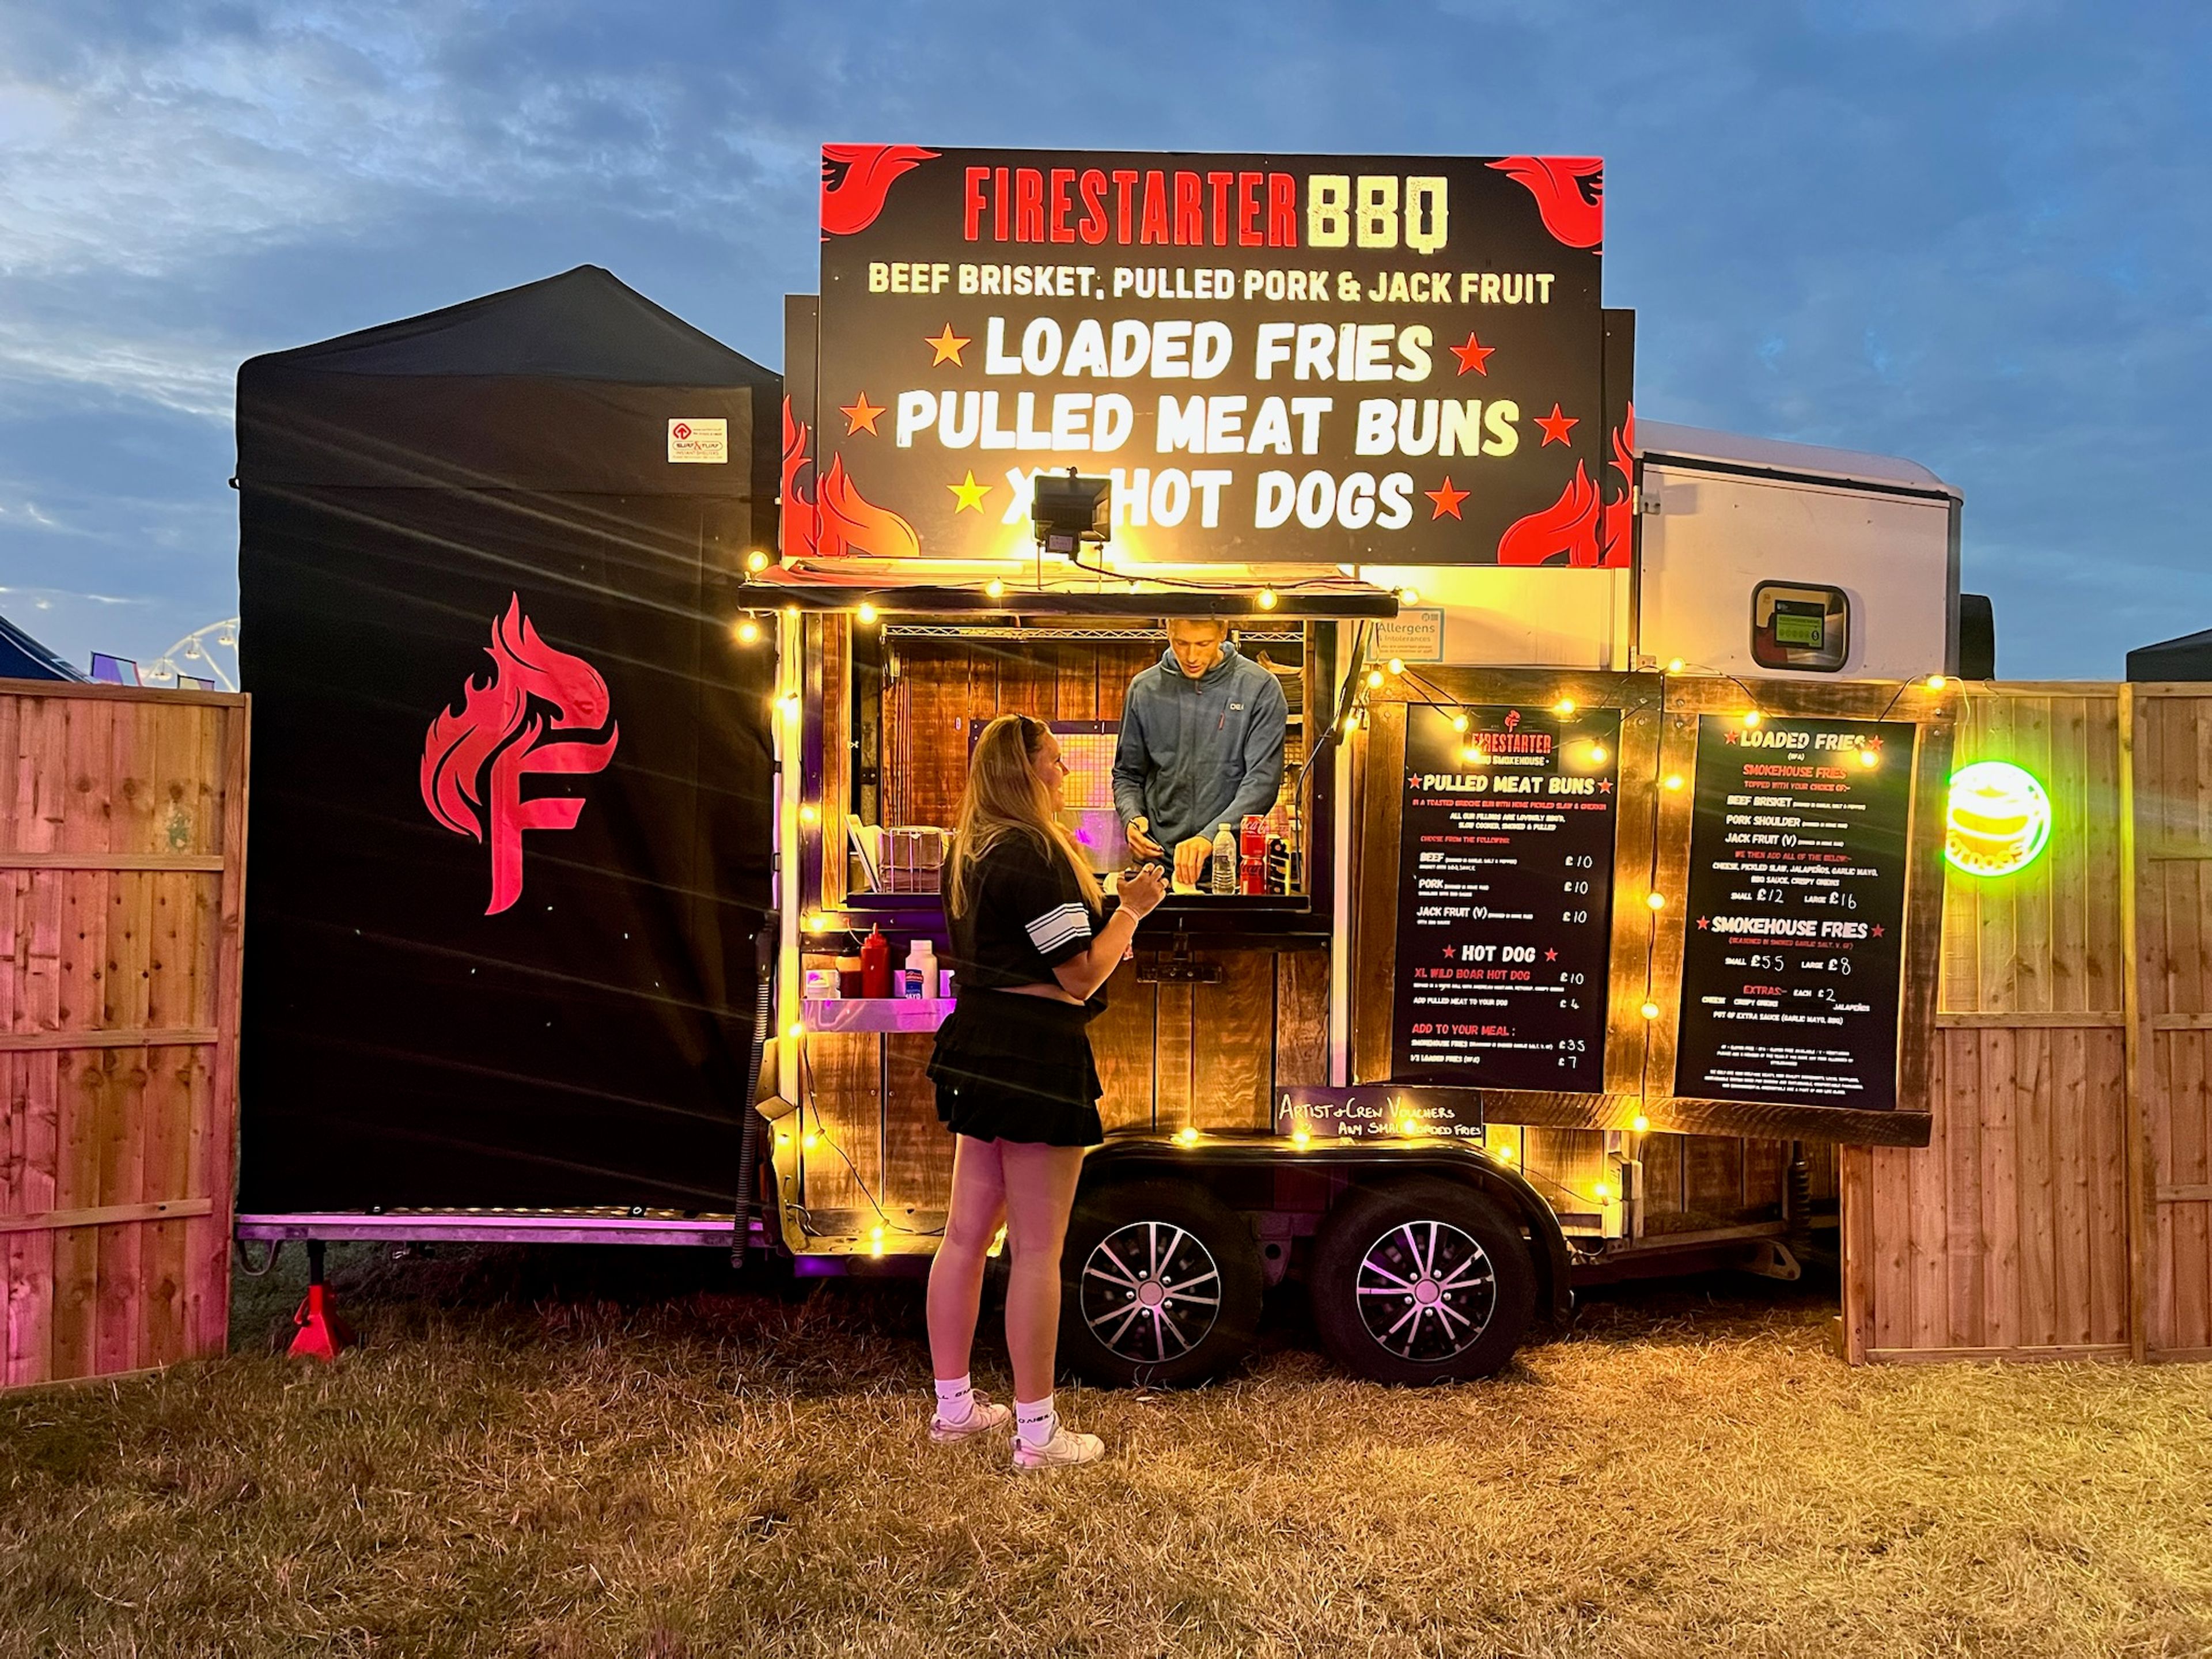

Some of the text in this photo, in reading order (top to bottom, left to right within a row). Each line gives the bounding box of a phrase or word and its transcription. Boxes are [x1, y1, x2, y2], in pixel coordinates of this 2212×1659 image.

[964, 166, 1449, 254] FIRESTARTER BBQ
[869, 262, 950, 293] BEEF
[1113, 267, 1234, 300] PULLED
[1244, 270, 1329, 301] PORK
[1338, 272, 1360, 301] &
[1369, 272, 1452, 303] JACK
[1460, 273, 1554, 304] FRUIT
[986, 316, 1434, 382] LOADED FRIES
[896, 390, 1520, 457] PULLED MEAT BUNS
[1110, 468, 1414, 529] HOT DOGS
[1378, 623, 1435, 635] Allergens
[1740, 730, 1866, 751] LOADED FRIES
[1493, 756, 1545, 766] SMOKEHOUSE
[1743, 764, 1847, 779] SMOKEHOUSE FRIES
[1423, 774, 1595, 795] PULLED MEAT BUNS
[1727, 795, 1752, 805] BEEF
[1753, 796, 1793, 807] BRISKET
[1726, 815, 1752, 825] PORK
[1753, 816, 1801, 827] SHOULDER
[1725, 833, 1751, 843] JACK
[1752, 834, 1779, 844] FRUIT
[1782, 834, 1797, 847] (V)
[1419, 852, 1445, 862] BEEF
[1418, 879, 1444, 888] PORK
[1756, 888, 1783, 903] £12
[1416, 906, 1442, 916] JACK
[1443, 907, 1470, 917] FRUIT
[1472, 906, 1487, 919] (V)
[1711, 916, 1868, 939] SMOKEHOUSE FRIES
[1461, 945, 1535, 963] HOT DOG
[1414, 968, 1427, 977] XL
[1430, 968, 1453, 978] WILD
[1456, 969, 1484, 979] BOAR
[1487, 970, 1508, 980] HOT
[1510, 971, 1530, 980] DOG
[1412, 1023, 1433, 1033] ADD
[1435, 1024, 1449, 1034] TO
[1452, 1024, 1478, 1035] YOUR
